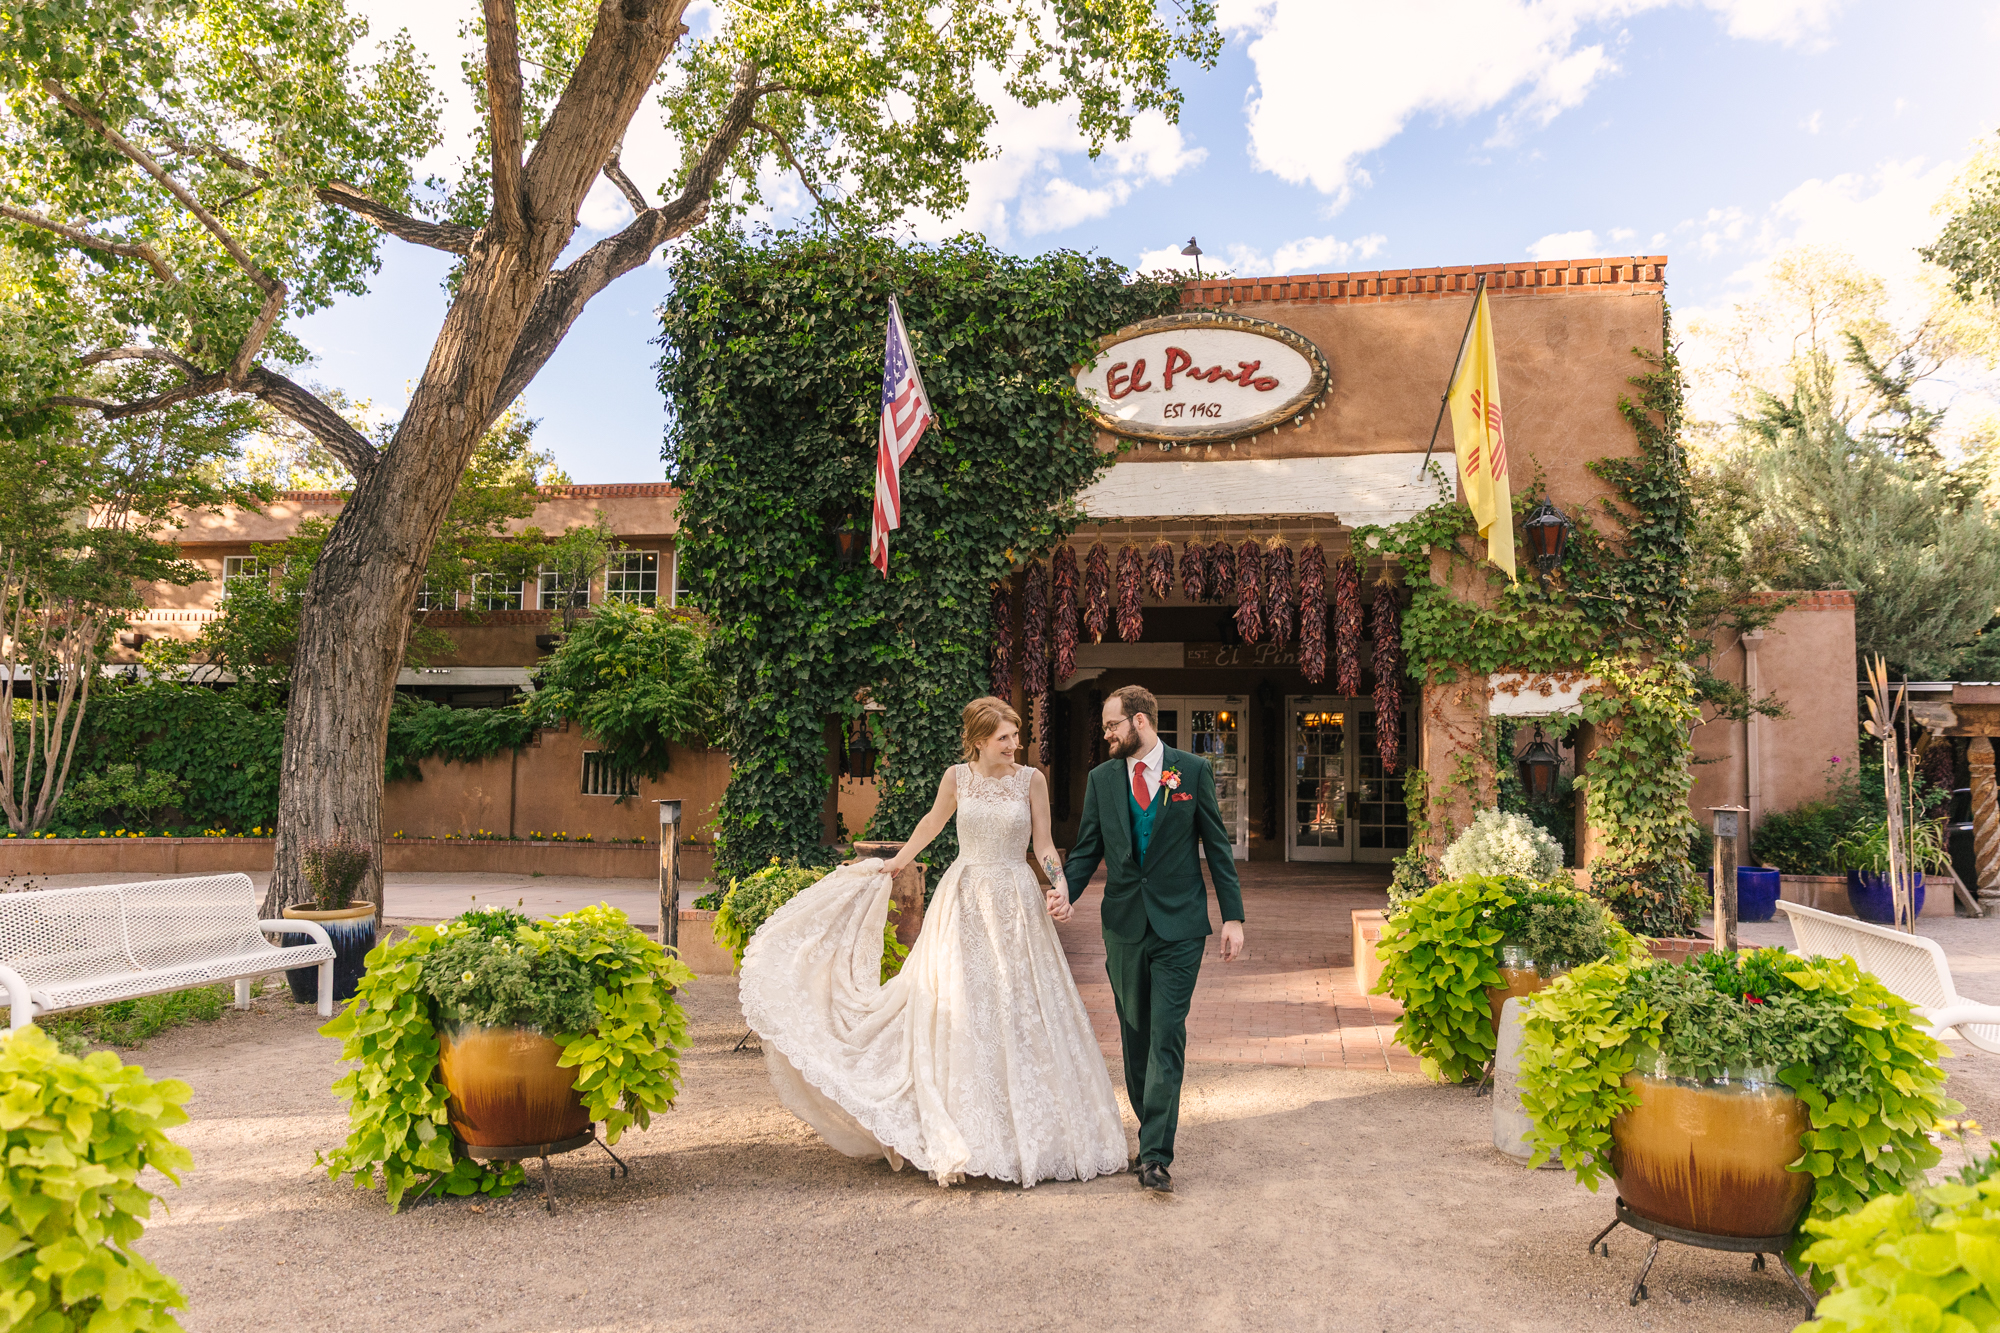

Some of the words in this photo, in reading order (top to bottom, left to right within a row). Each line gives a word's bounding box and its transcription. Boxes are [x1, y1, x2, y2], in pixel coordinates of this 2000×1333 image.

[1106, 358, 1152, 400] El
[1162, 346, 1279, 392] Pinto
[1164, 402, 1186, 418] EST
[1189, 402, 1222, 418] 1962
[1187, 650, 1209, 659] EST.
[1215, 644, 1241, 666] El
